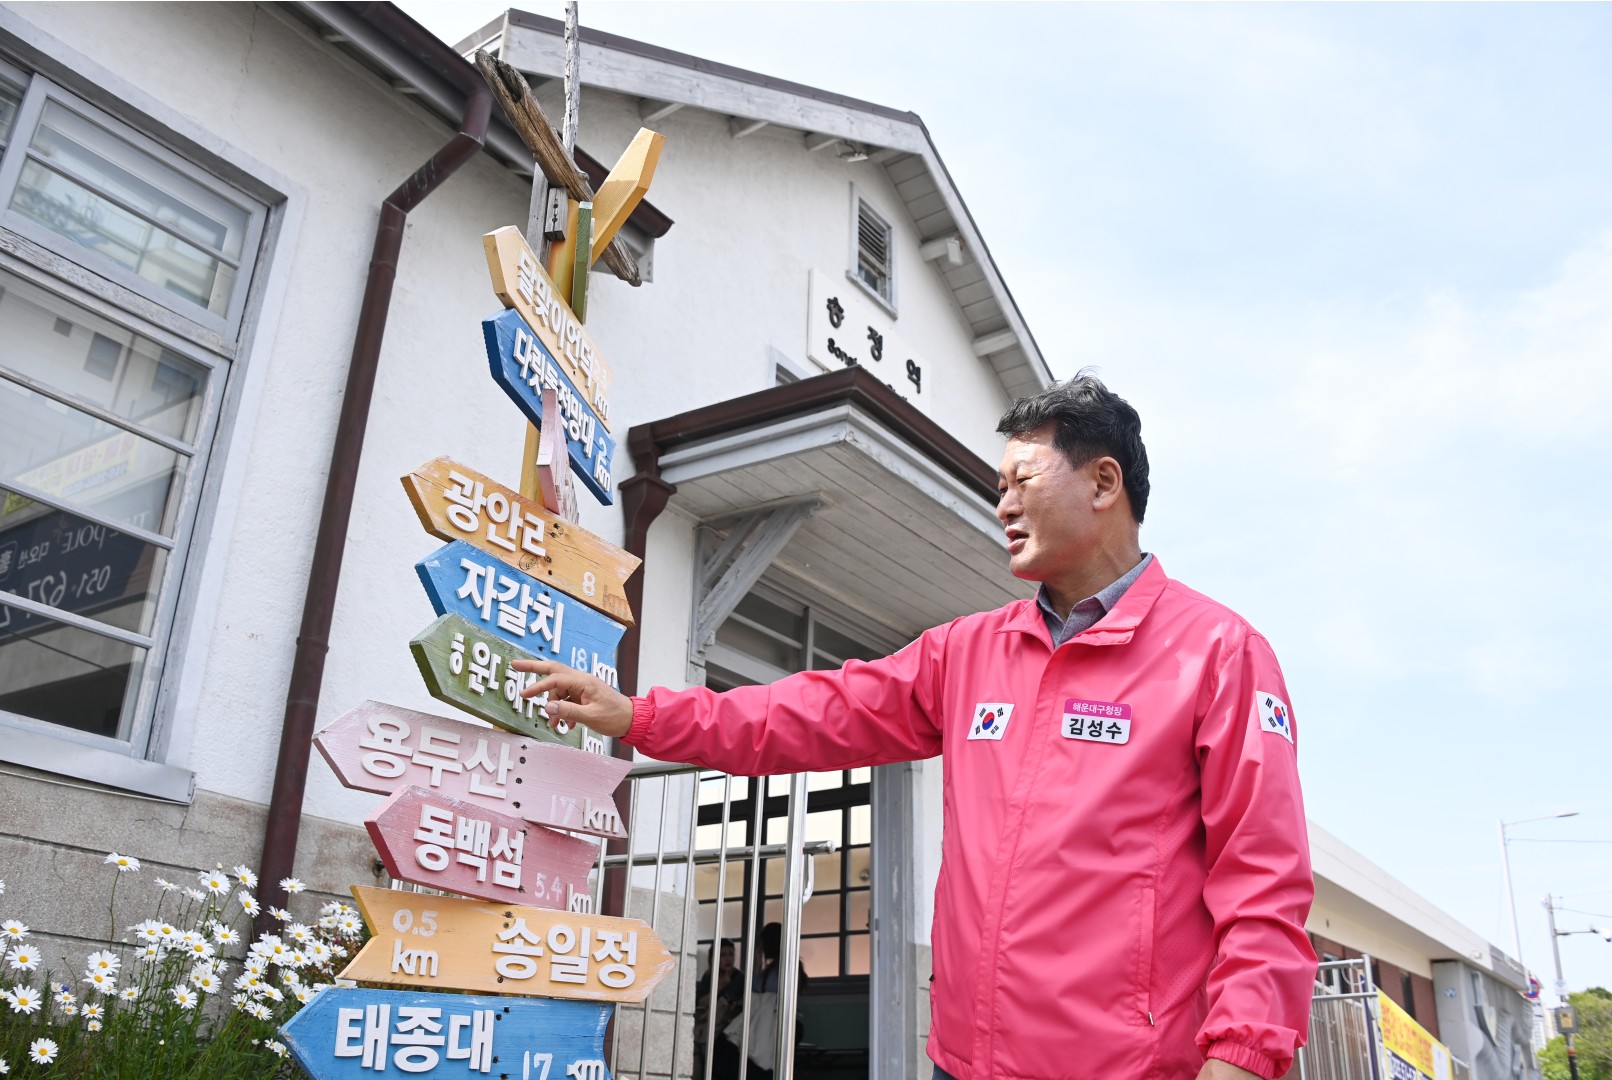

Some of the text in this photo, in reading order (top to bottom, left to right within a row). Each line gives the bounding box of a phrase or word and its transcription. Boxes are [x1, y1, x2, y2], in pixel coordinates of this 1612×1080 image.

[516, 249, 595, 388] 달맞이언덕
[593, 382, 609, 420] km
[594, 451, 611, 492] km
[443, 469, 548, 558] 광안리
[583, 571, 596, 598] 8
[456, 558, 565, 654] 자갈치
[570, 646, 618, 689] 18 km
[1069, 718, 1123, 740] 김성수
[1072, 702, 1123, 717] 해운대구청장
[359, 714, 515, 800] 용두산
[550, 793, 621, 834] 17 km
[413, 804, 525, 889] 동백섬
[566, 883, 593, 914] km
[392, 908, 438, 938] 0.5
[391, 940, 439, 978] km
[491, 918, 638, 989] 송일정
[334, 1003, 496, 1074] 태종대
[522, 1050, 553, 1080] 17
